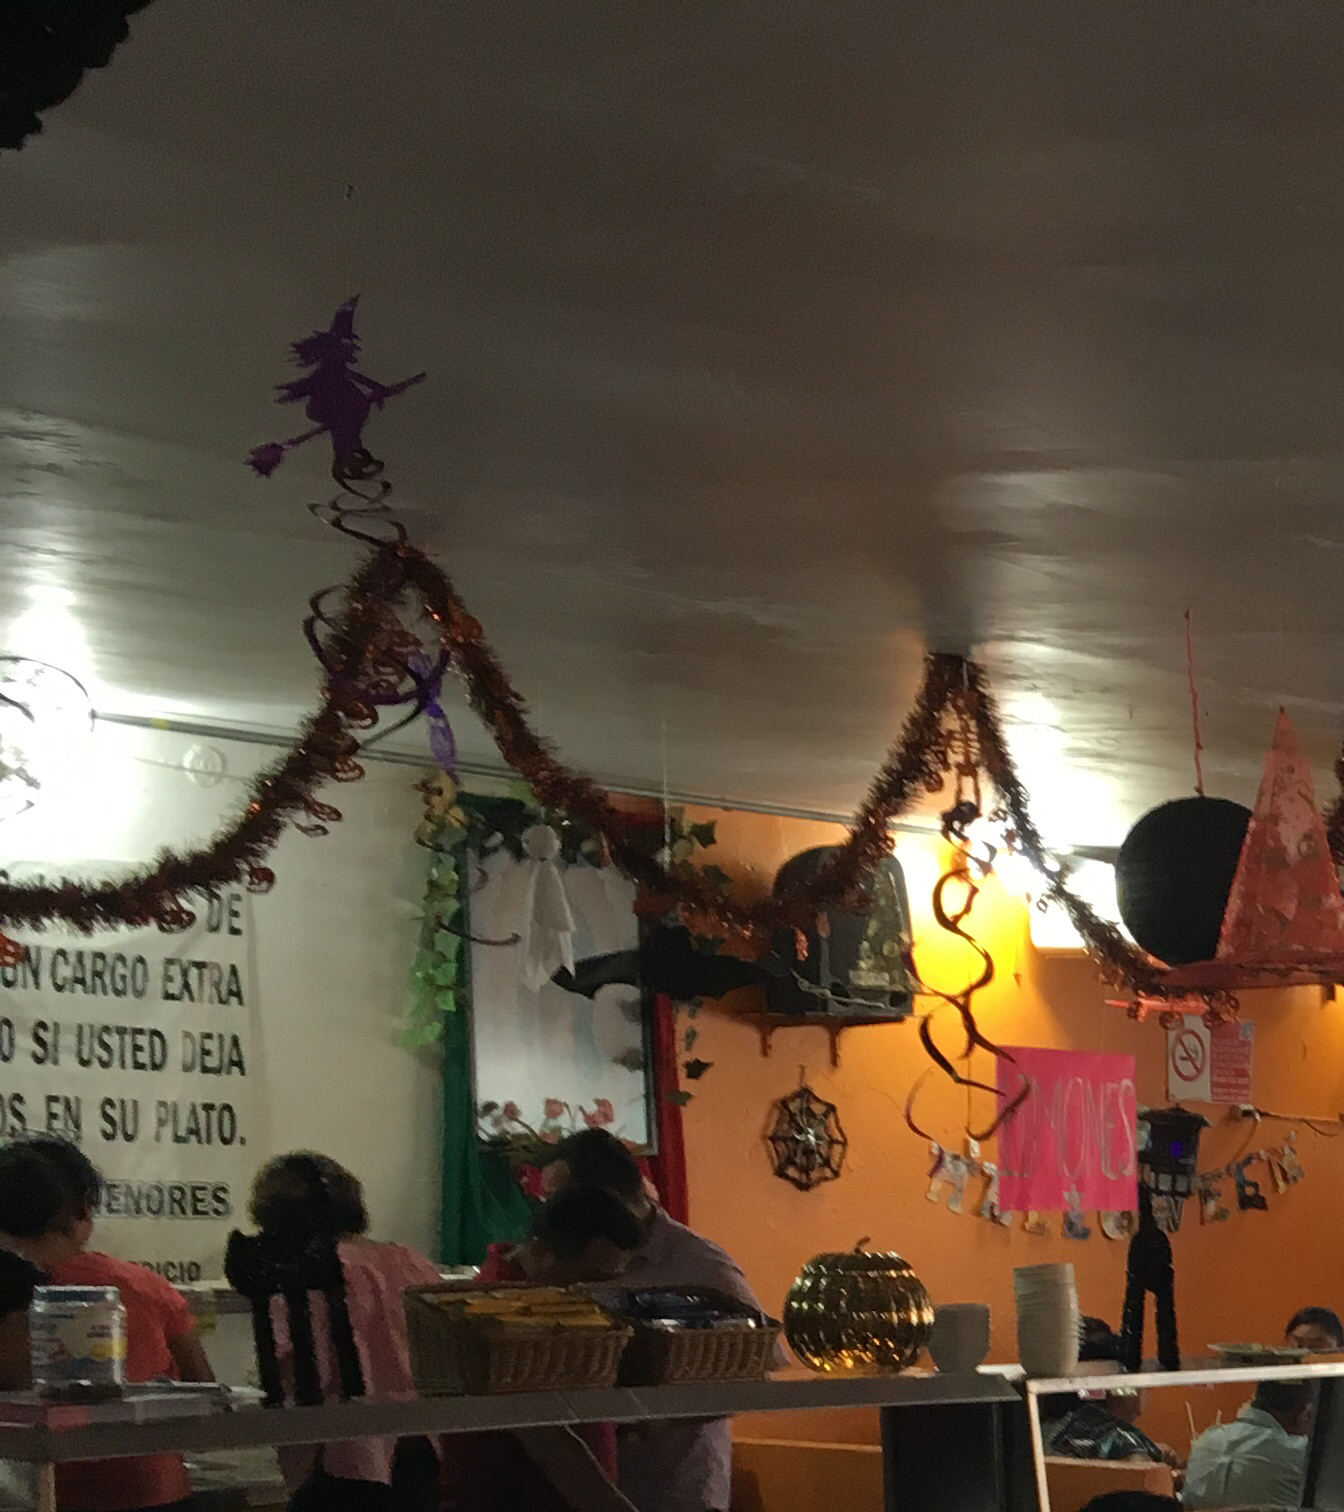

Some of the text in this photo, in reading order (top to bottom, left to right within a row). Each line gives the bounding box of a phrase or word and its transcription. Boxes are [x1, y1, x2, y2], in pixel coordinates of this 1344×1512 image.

[51, 948, 149, 999] CARGO
[162, 957, 244, 1007] EXTRA
[31, 1019, 60, 1066] SI
[75, 1023, 168, 1071] USTED
[181, 1030, 246, 1077] DEJA
[45, 1094, 82, 1142] EN
[101, 1096, 139, 1142] SU
[154, 1100, 247, 1146] PLATO.
[98, 1182, 231, 1217] ENORES
